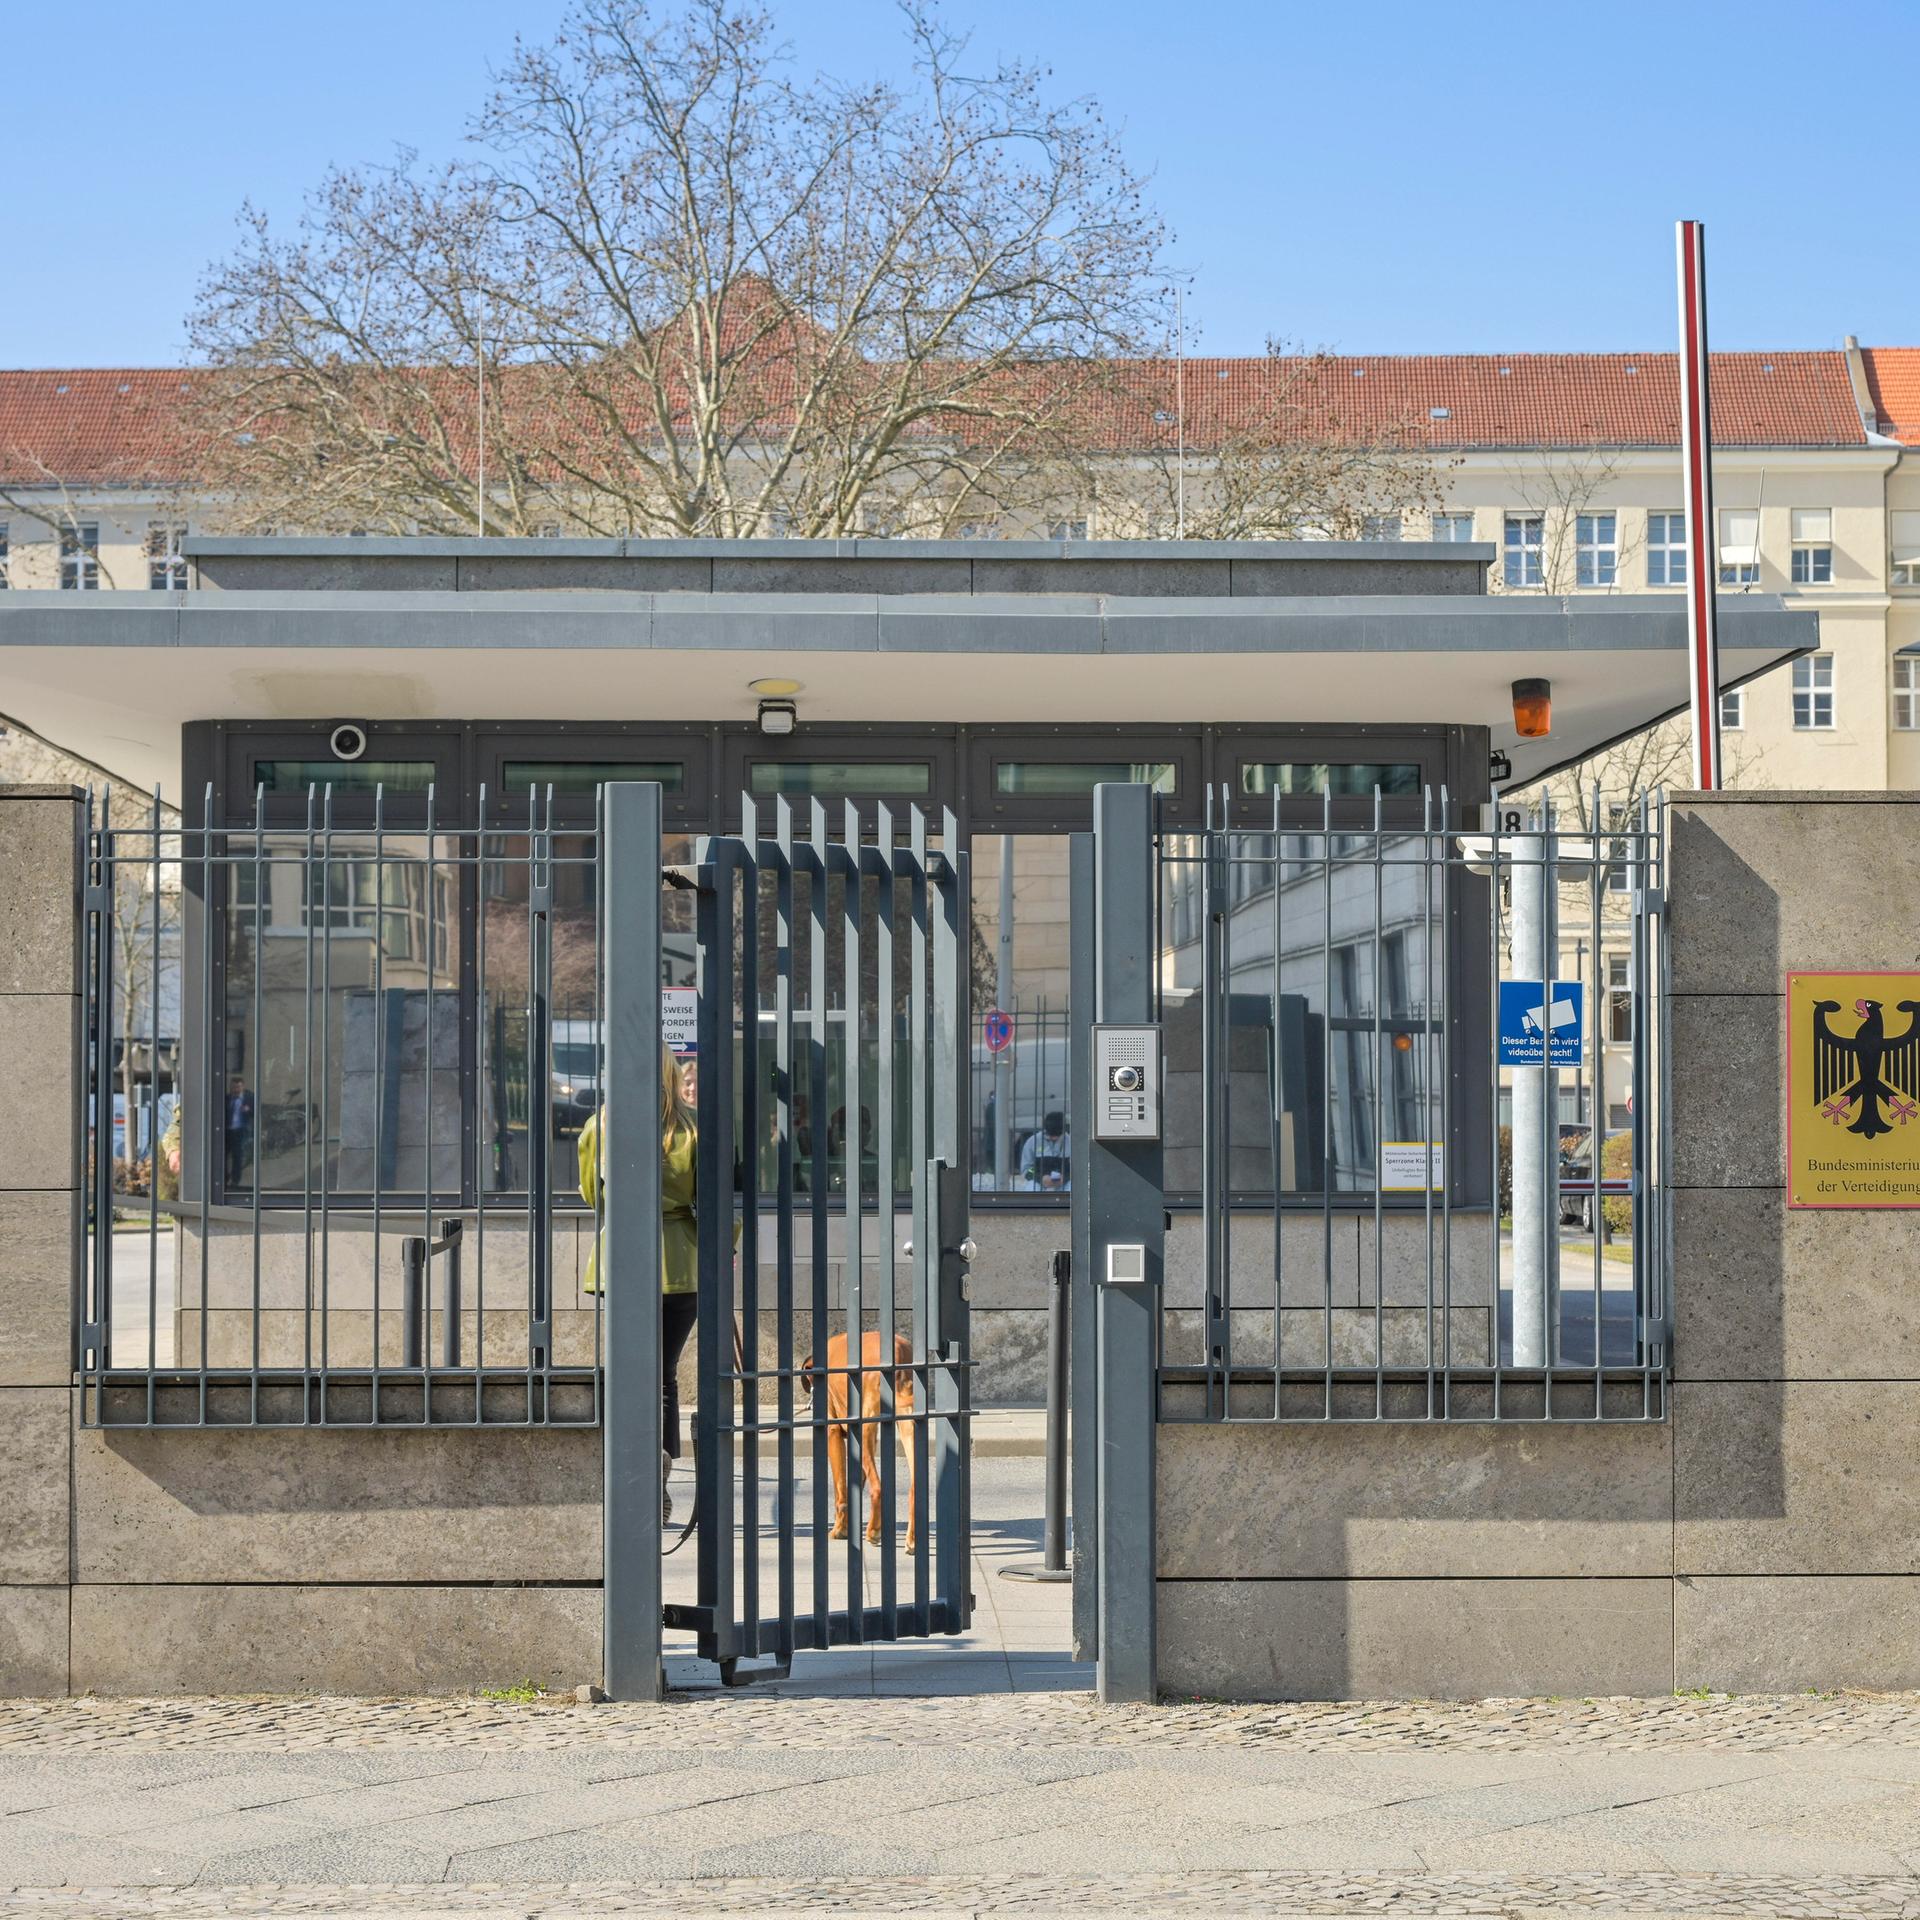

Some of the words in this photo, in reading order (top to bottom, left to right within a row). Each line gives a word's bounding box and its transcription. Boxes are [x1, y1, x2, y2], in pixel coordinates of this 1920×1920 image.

[662, 1019, 697, 1027] FORDER
[1502, 1036, 1528, 1045] Dieser
[1529, 1036, 1560, 1046] Berch
[1561, 1037, 1579, 1046] wird
[1508, 1048, 1573, 1057] videoübeacht!
[1385, 1157, 1414, 1165] Sperrzone
[1808, 1158, 1920, 1171] Bundesministeriu
[1816, 1180, 1838, 1192] der
[1841, 1179, 1920, 1196] Verteidigung
